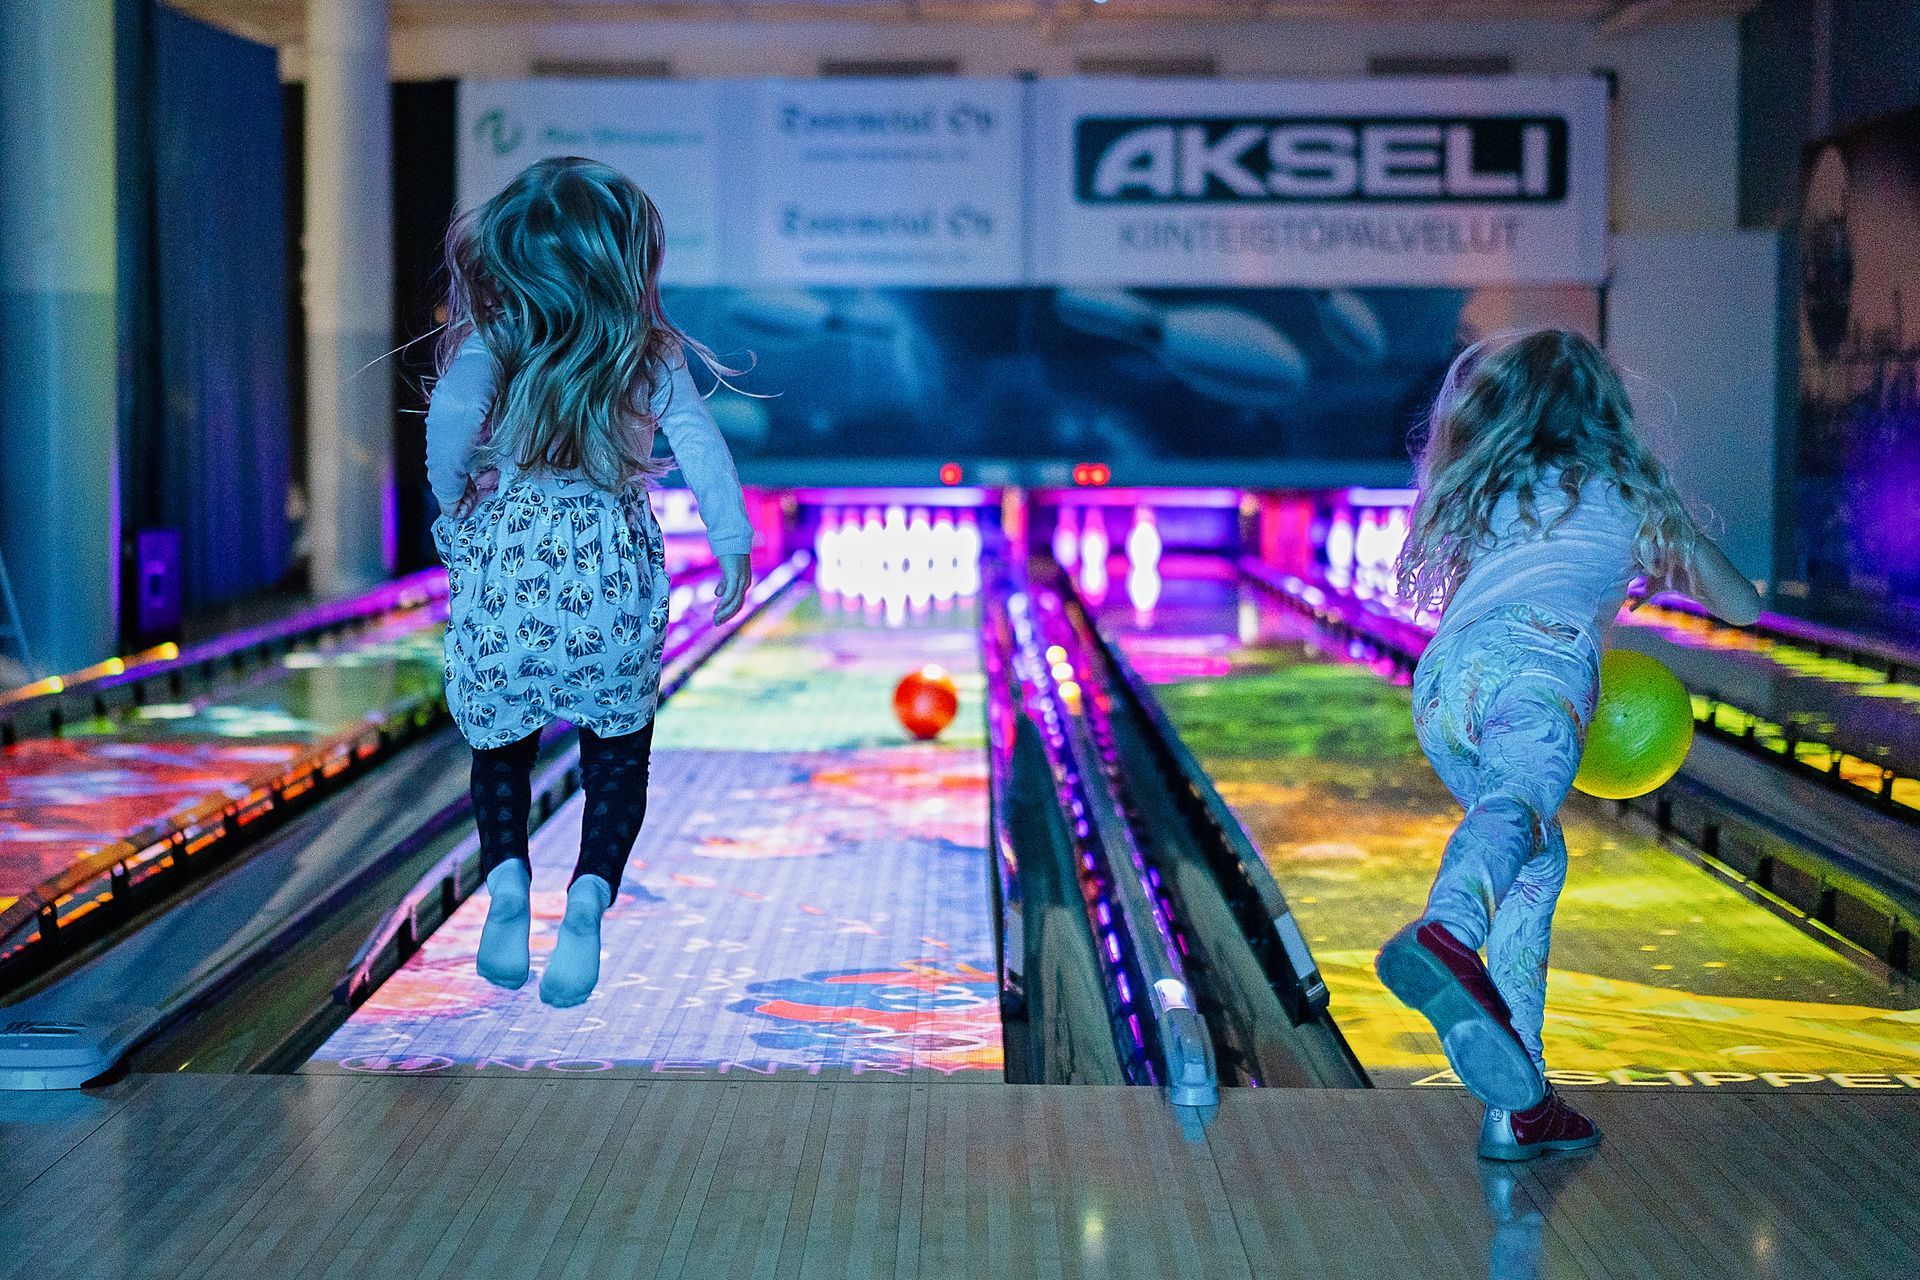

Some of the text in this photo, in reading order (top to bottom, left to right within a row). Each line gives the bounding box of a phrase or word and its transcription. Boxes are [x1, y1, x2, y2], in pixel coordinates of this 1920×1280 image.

[1095, 125, 1550, 198] AKSELI
[475, 1057, 983, 1076] NO ENTRY
